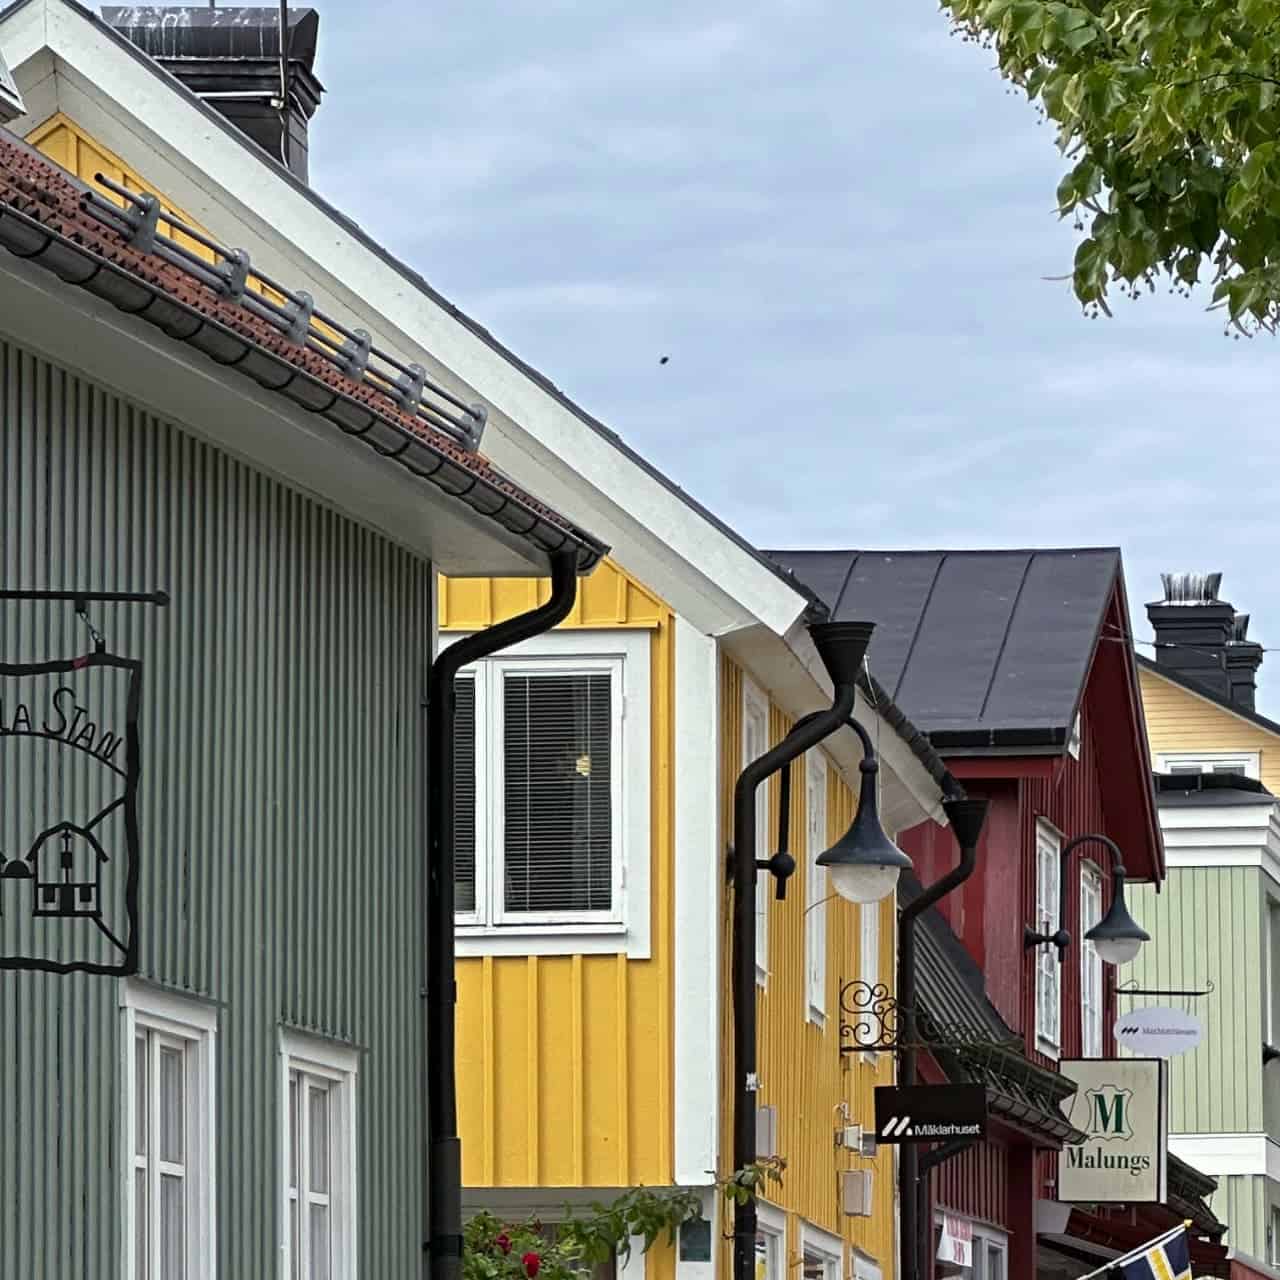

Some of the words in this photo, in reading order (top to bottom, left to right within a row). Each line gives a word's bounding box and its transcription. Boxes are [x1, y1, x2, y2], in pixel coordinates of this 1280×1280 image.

[914, 1122, 981, 1136] Mäklarhuset
[1091, 1094, 1126, 1134] M
[1066, 1146, 1151, 1176] Malungs
